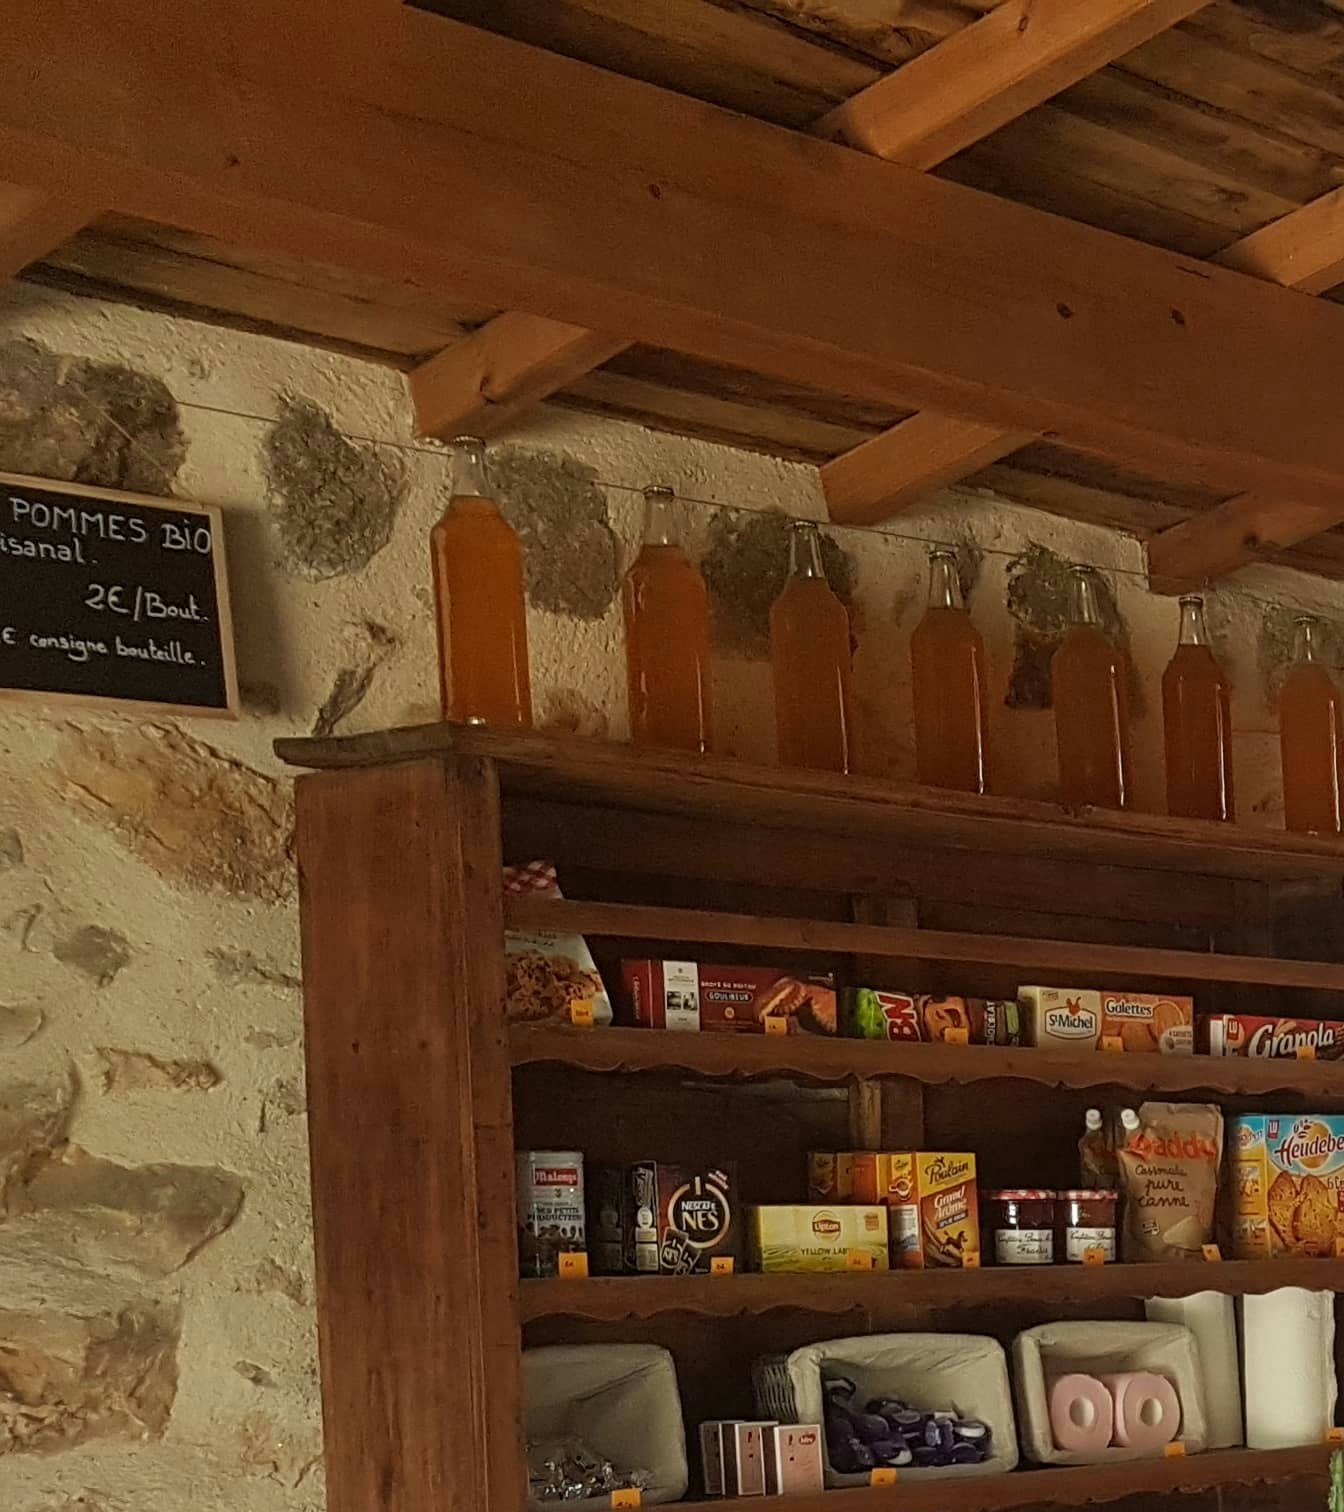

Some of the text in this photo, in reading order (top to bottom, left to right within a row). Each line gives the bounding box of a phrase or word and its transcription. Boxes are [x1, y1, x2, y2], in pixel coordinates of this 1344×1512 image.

[10, 497, 148, 543] POMMES
[29, 633, 108, 662] consigne
[1105, 998, 1153, 1016] Galettes
[1249, 1022, 1335, 1059] Granola
[925, 1159, 969, 1185] Poulain
[1145, 1177, 1184, 1192] pure
[1140, 1198, 1190, 1208] canne
[682, 1211, 719, 1231] NES
[814, 1221, 839, 1233] Lipton
[800, 1247, 830, 1256] YELLOW
